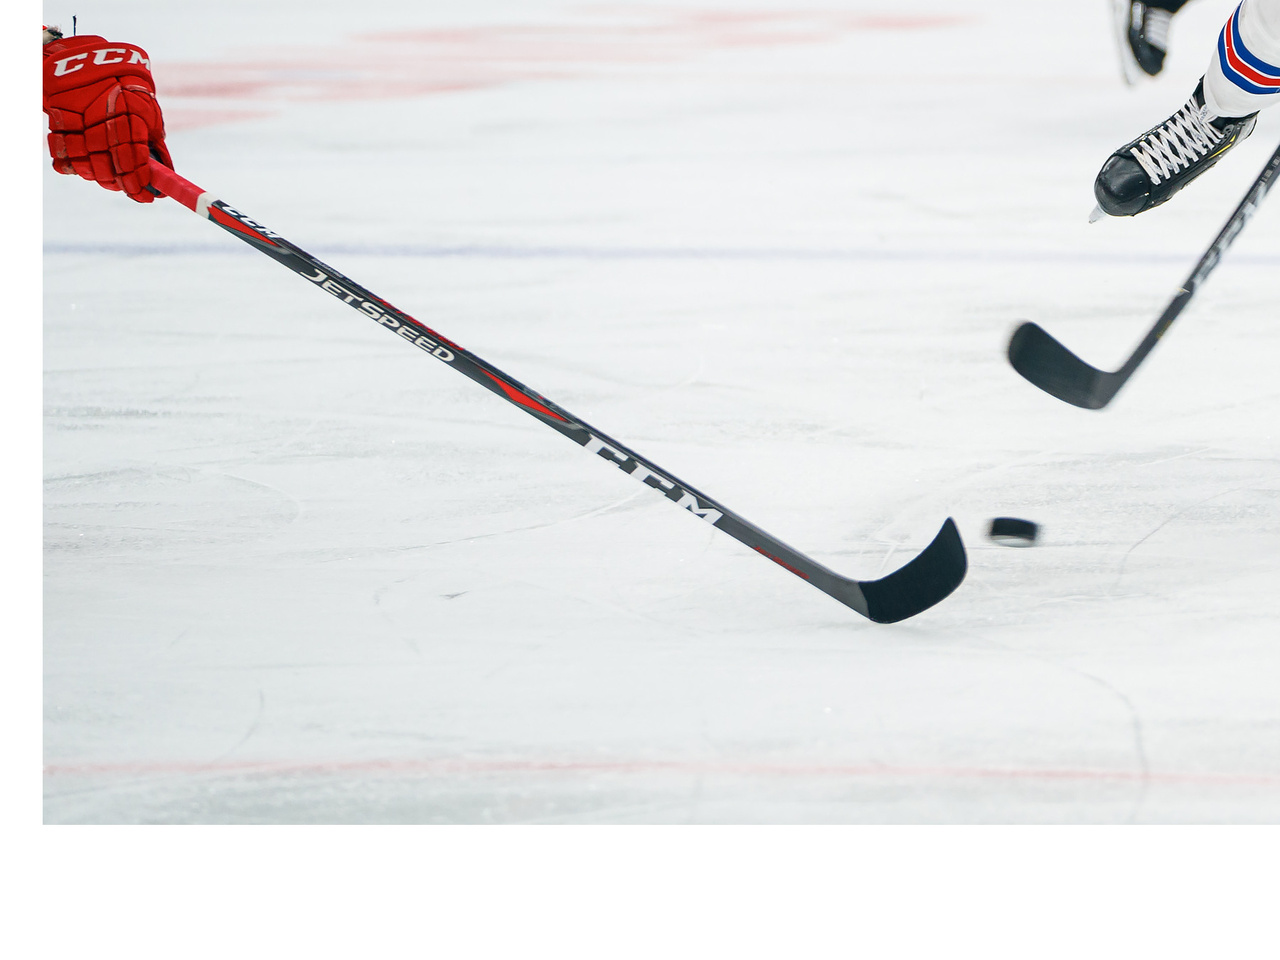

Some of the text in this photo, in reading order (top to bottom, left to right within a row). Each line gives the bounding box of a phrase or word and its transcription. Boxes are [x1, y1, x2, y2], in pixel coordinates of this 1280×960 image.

[53, 48, 151, 77] CCM
[221, 205, 281, 239] CCM
[300, 268, 455, 362] JETSPEED
[584, 433, 724, 525] CCM
